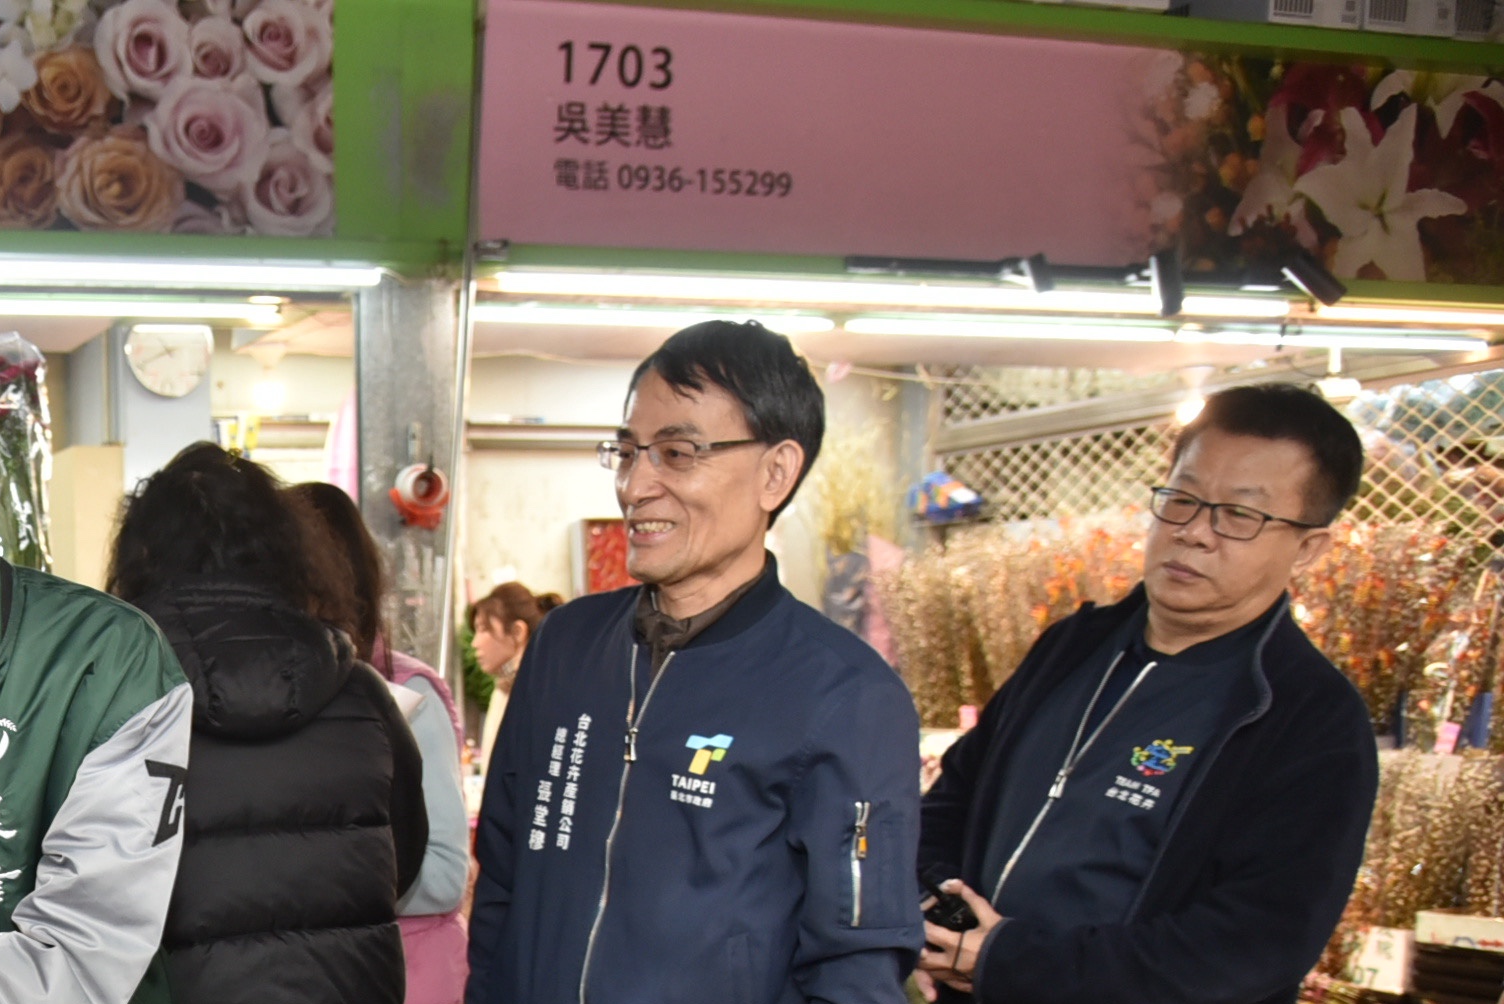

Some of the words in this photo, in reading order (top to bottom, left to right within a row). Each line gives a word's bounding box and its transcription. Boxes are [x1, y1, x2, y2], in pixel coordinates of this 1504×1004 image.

[558, 40, 674, 90] 1703
[553, 101, 672, 149] 吳美慧
[554, 159, 609, 191] 電話
[617, 164, 793, 198] 0936-155299
[556, 713, 592, 850] 台北花卉產銷公司
[671, 773, 716, 795] TAIPEI
